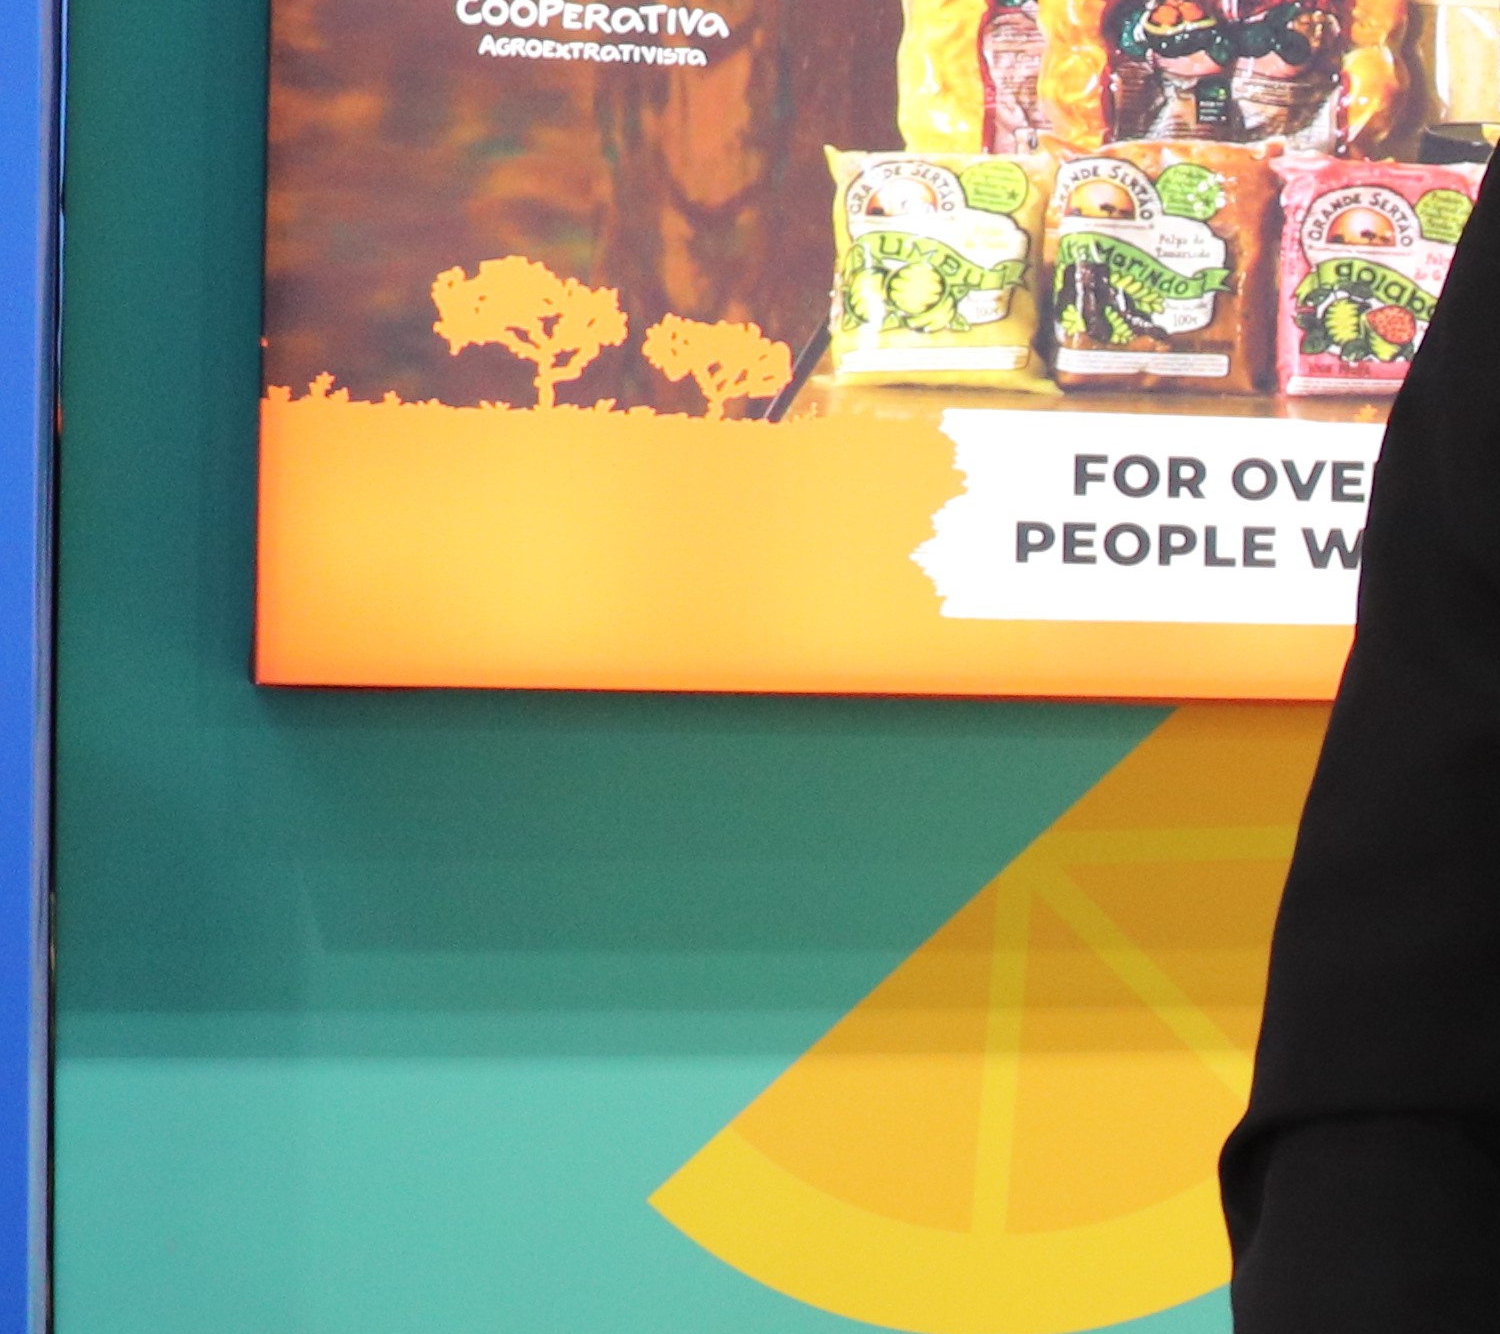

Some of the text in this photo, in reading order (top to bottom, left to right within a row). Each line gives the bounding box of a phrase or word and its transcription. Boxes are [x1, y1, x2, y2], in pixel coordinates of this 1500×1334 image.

[848, 165, 900, 215] GRADE
[1308, 192, 1362, 241] GRANDE
[1369, 192, 1414, 248] SERTÃO
[879, 234, 986, 291] UMBU
[1072, 453, 1378, 504] FOR OVE
[1014, 520, 1367, 570] PEOPLE W
